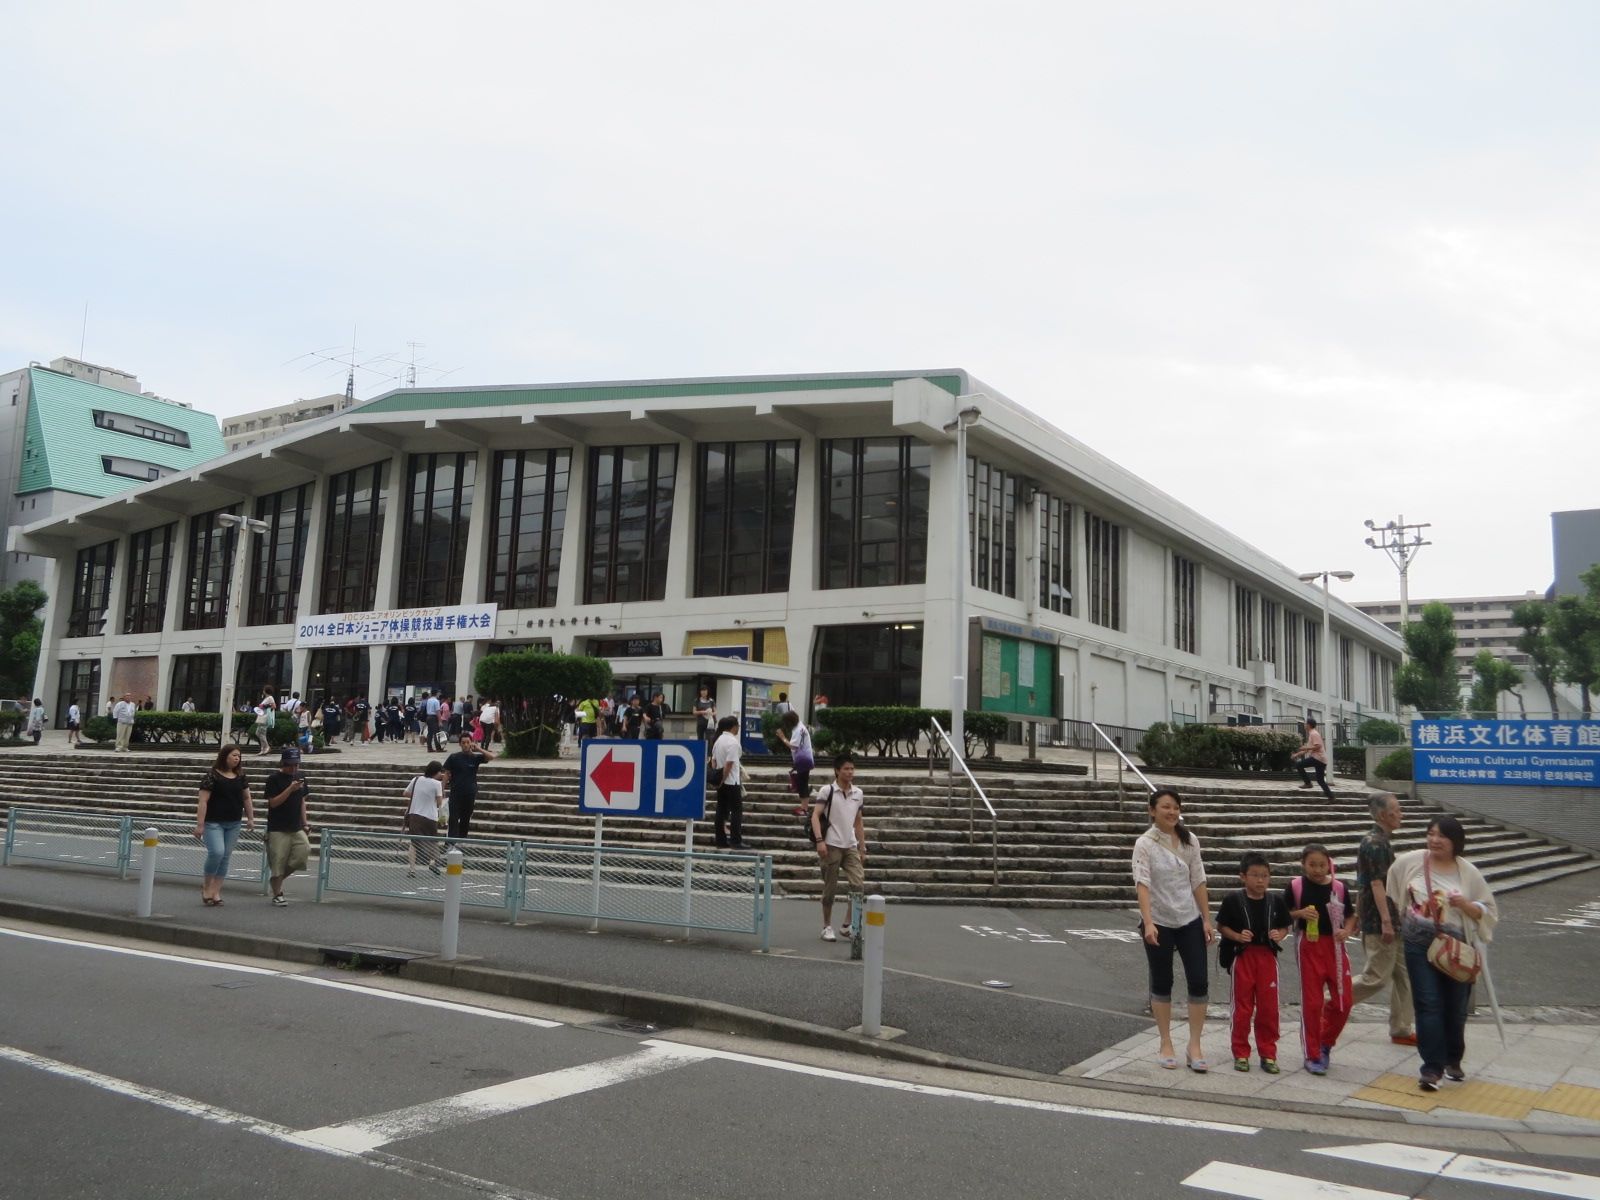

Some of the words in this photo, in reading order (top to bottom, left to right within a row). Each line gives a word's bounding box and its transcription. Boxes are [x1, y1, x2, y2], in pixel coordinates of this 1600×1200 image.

[1418, 725, 1600, 746] 横浜文化体育館
[1428, 755, 1480, 765] Yokohama
[1484, 756, 1527, 766] Cultural
[1531, 756, 1594, 768] Gymnasium
[654, 744, 695, 814] P
